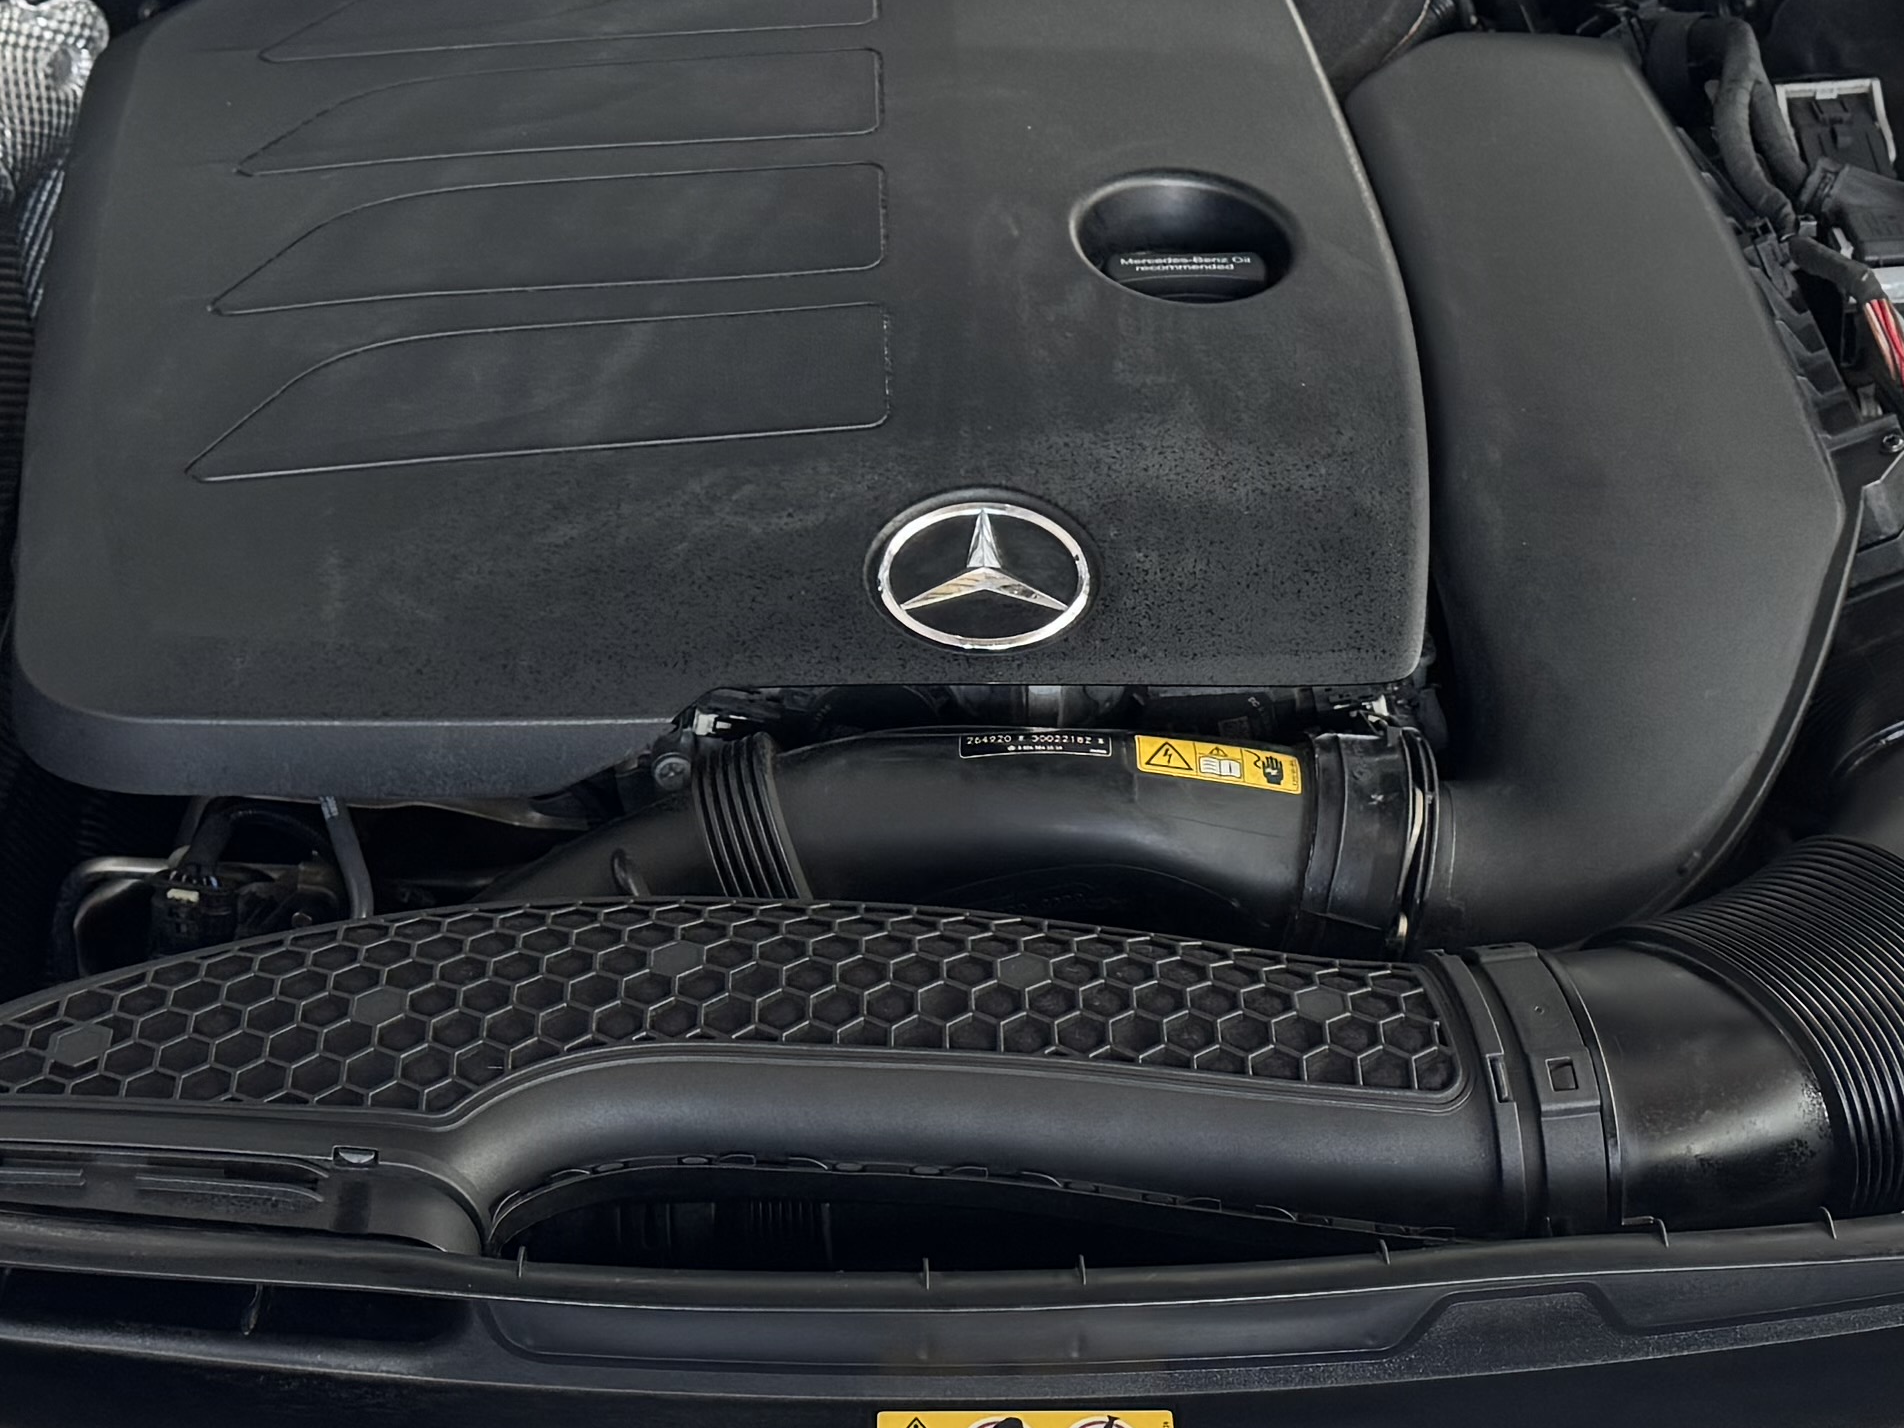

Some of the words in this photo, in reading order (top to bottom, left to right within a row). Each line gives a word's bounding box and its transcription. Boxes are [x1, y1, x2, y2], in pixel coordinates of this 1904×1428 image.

[1120, 256, 1228, 265] Mercedes-Benz
[1231, 256, 1251, 264] Oil
[1135, 263, 1235, 272] recommended
[966, 735, 1012, 745] 264920
